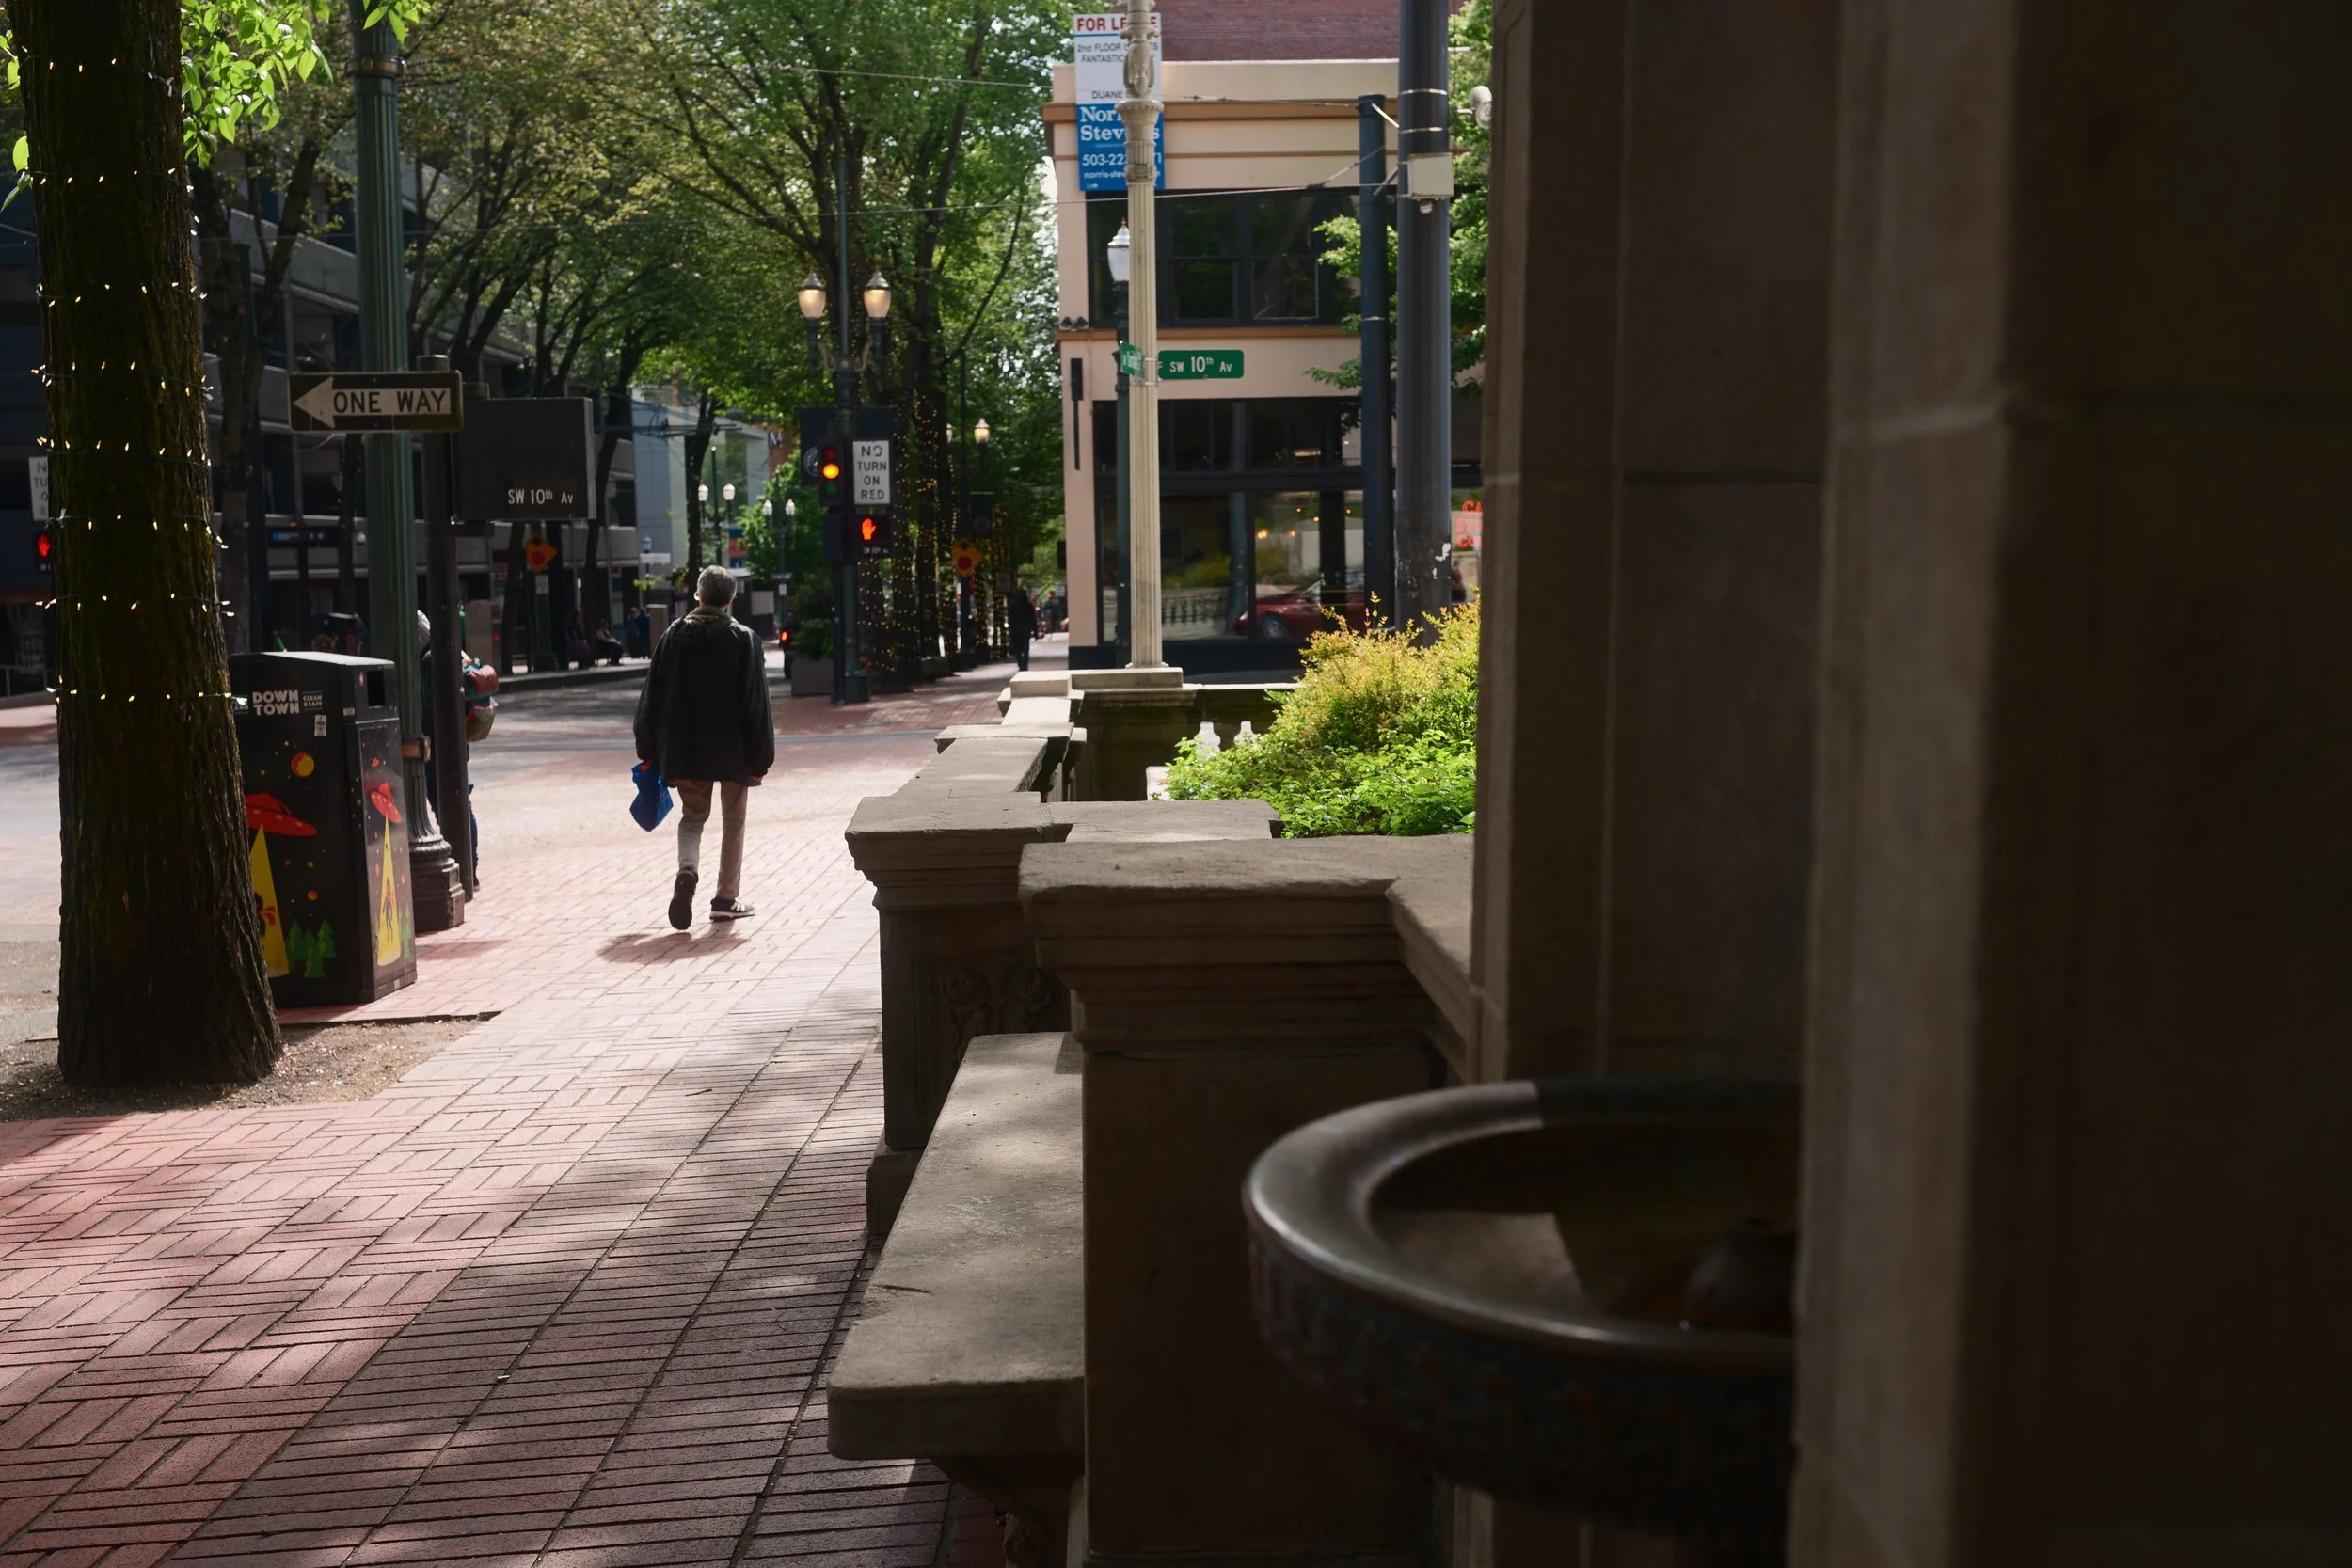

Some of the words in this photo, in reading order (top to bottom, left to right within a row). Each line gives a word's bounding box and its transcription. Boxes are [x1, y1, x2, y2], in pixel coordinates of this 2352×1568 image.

[1077, 18, 1106, 31] FOR
[1111, 16, 1157, 30] LEE
[1094, 43, 1121, 52] FLOOR
[1169, 361, 1185, 373] SW
[1190, 356, 1214, 372] 10th
[1219, 361, 1232, 372] Av
[333, 391, 382, 414] ONE
[396, 390, 447, 413] WAY
[861, 445, 882, 457] NO
[857, 462, 887, 471] TURN
[864, 476, 880, 485] ON
[508, 489, 525, 504] SW
[531, 489, 553, 504] 10th
[561, 491, 574, 504] Av
[861, 490, 884, 500] RED
[252, 689, 299, 705] DOWN
[253, 703, 300, 716] TOWN
